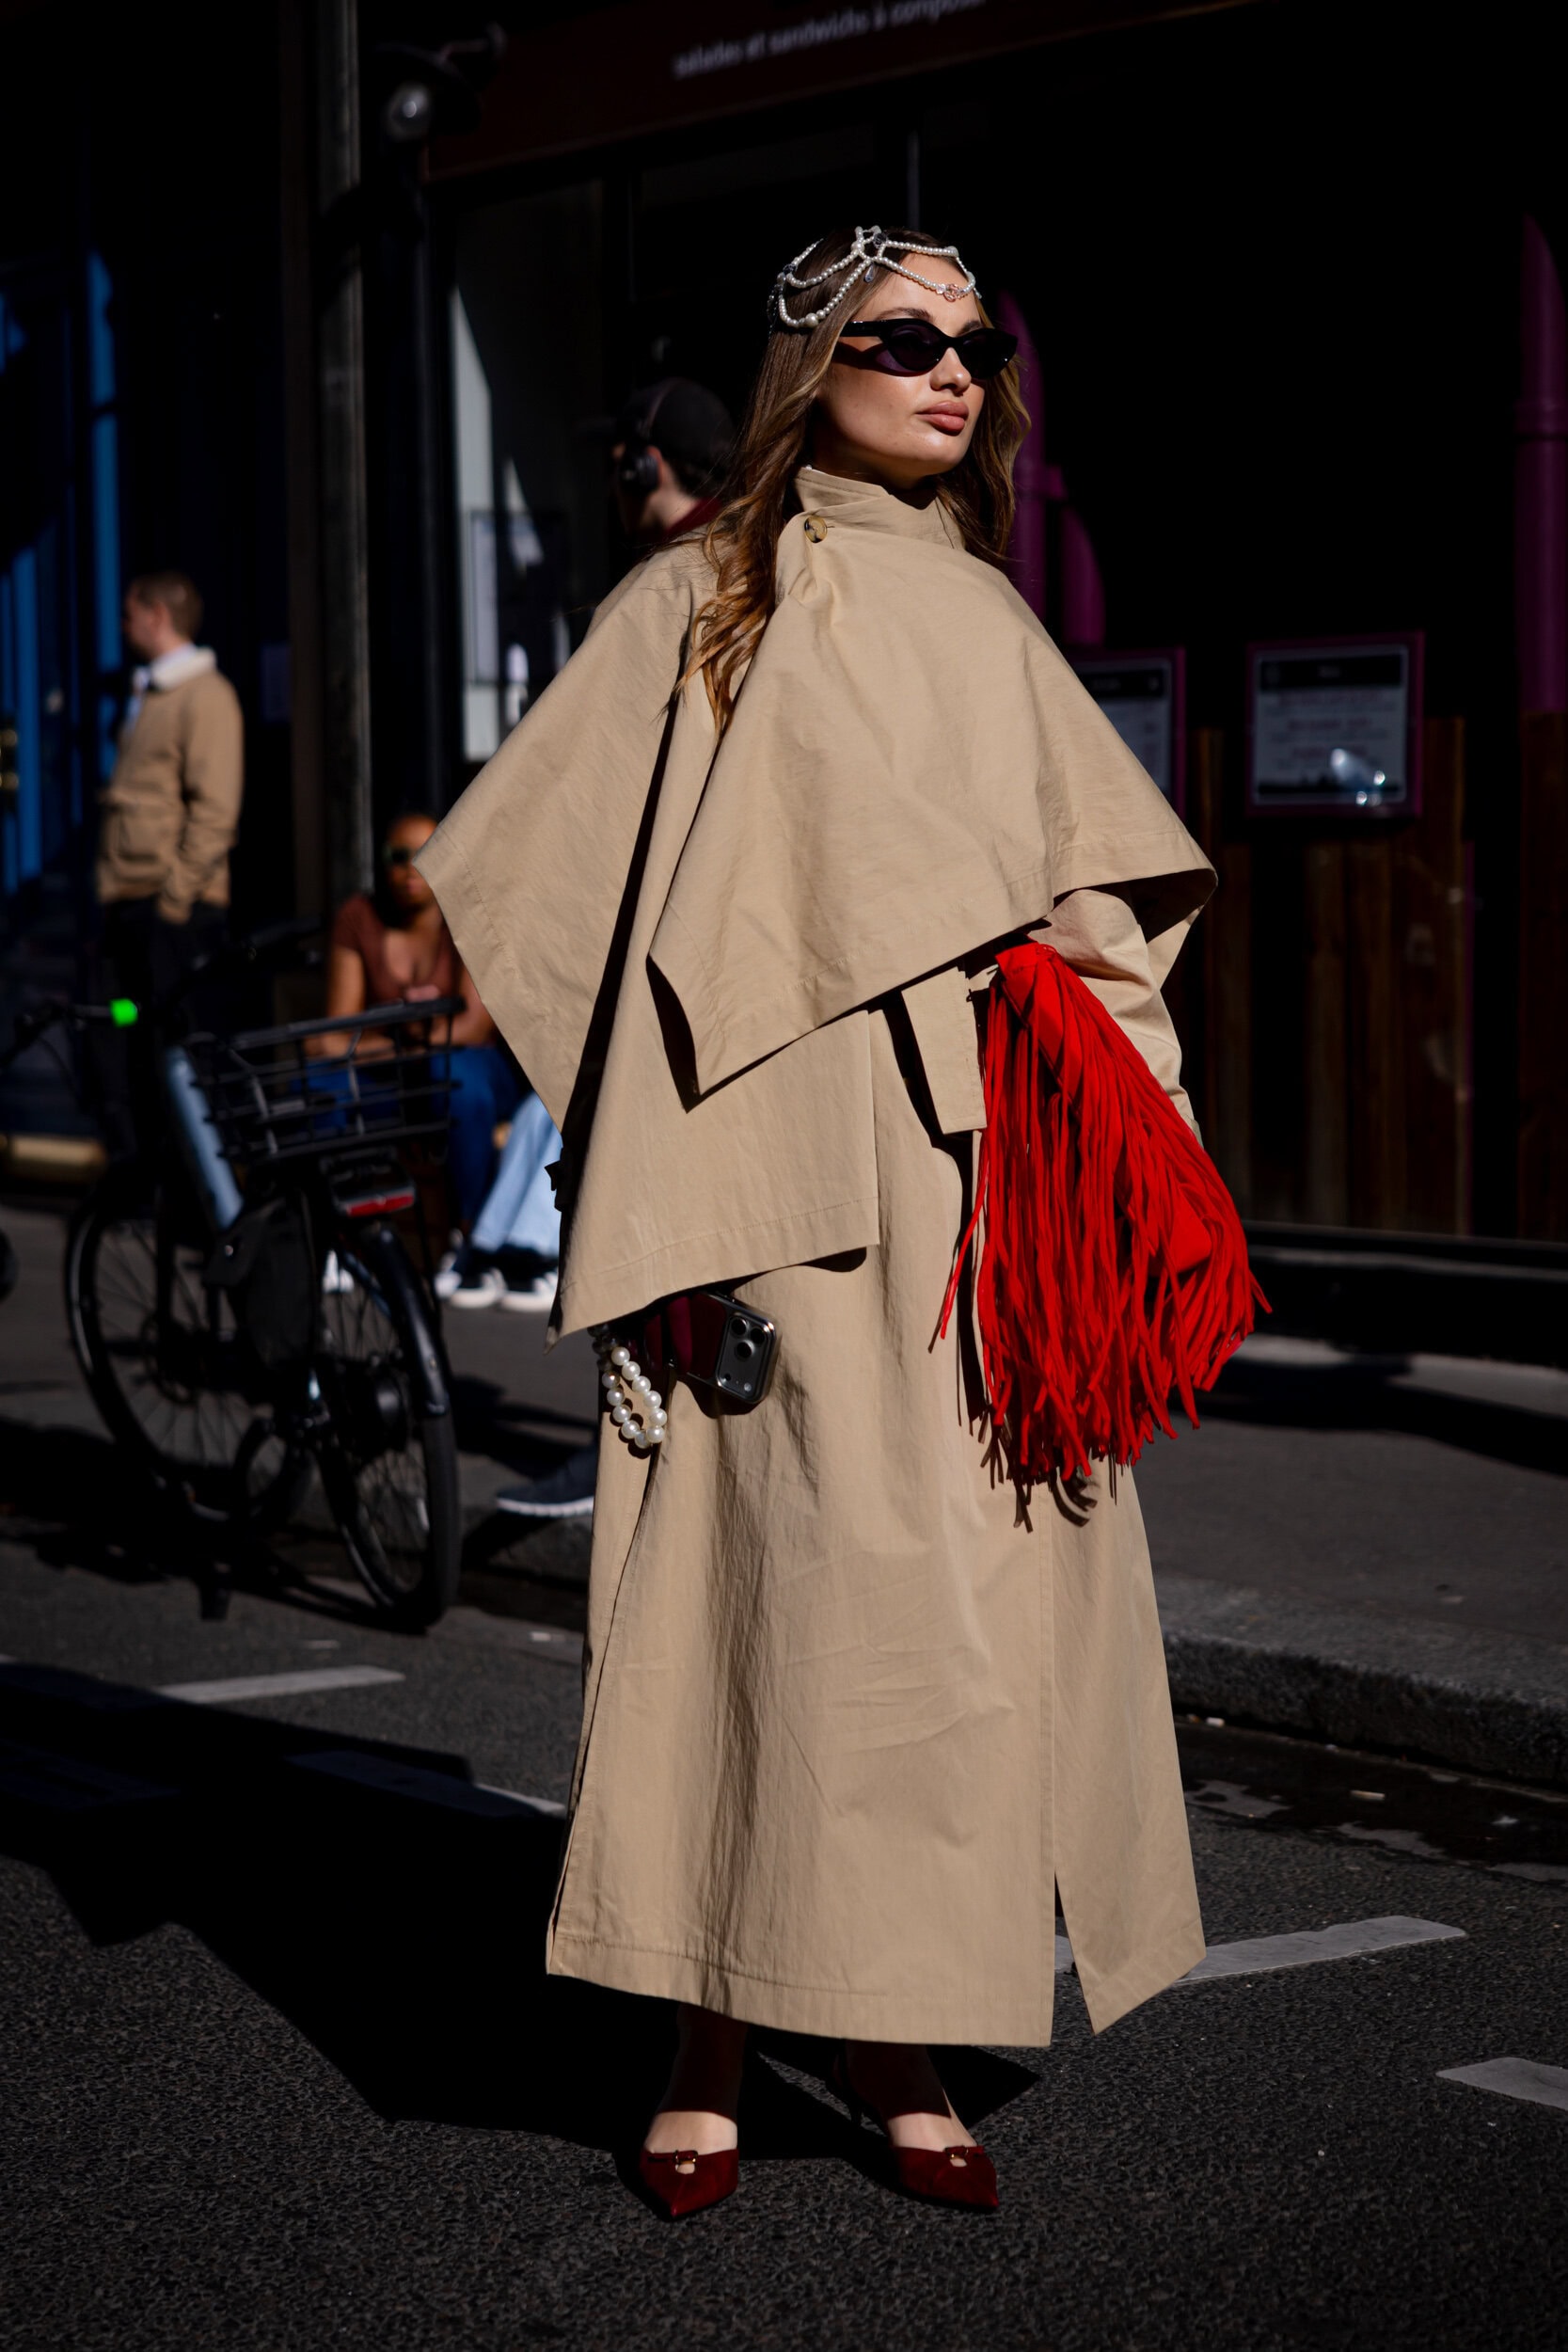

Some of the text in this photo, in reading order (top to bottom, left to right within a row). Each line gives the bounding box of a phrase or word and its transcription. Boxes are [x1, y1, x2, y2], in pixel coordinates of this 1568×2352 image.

[674, 41, 744, 80] salades
[745, 32, 767, 62] et
[889, 0, 985, 26] compo
